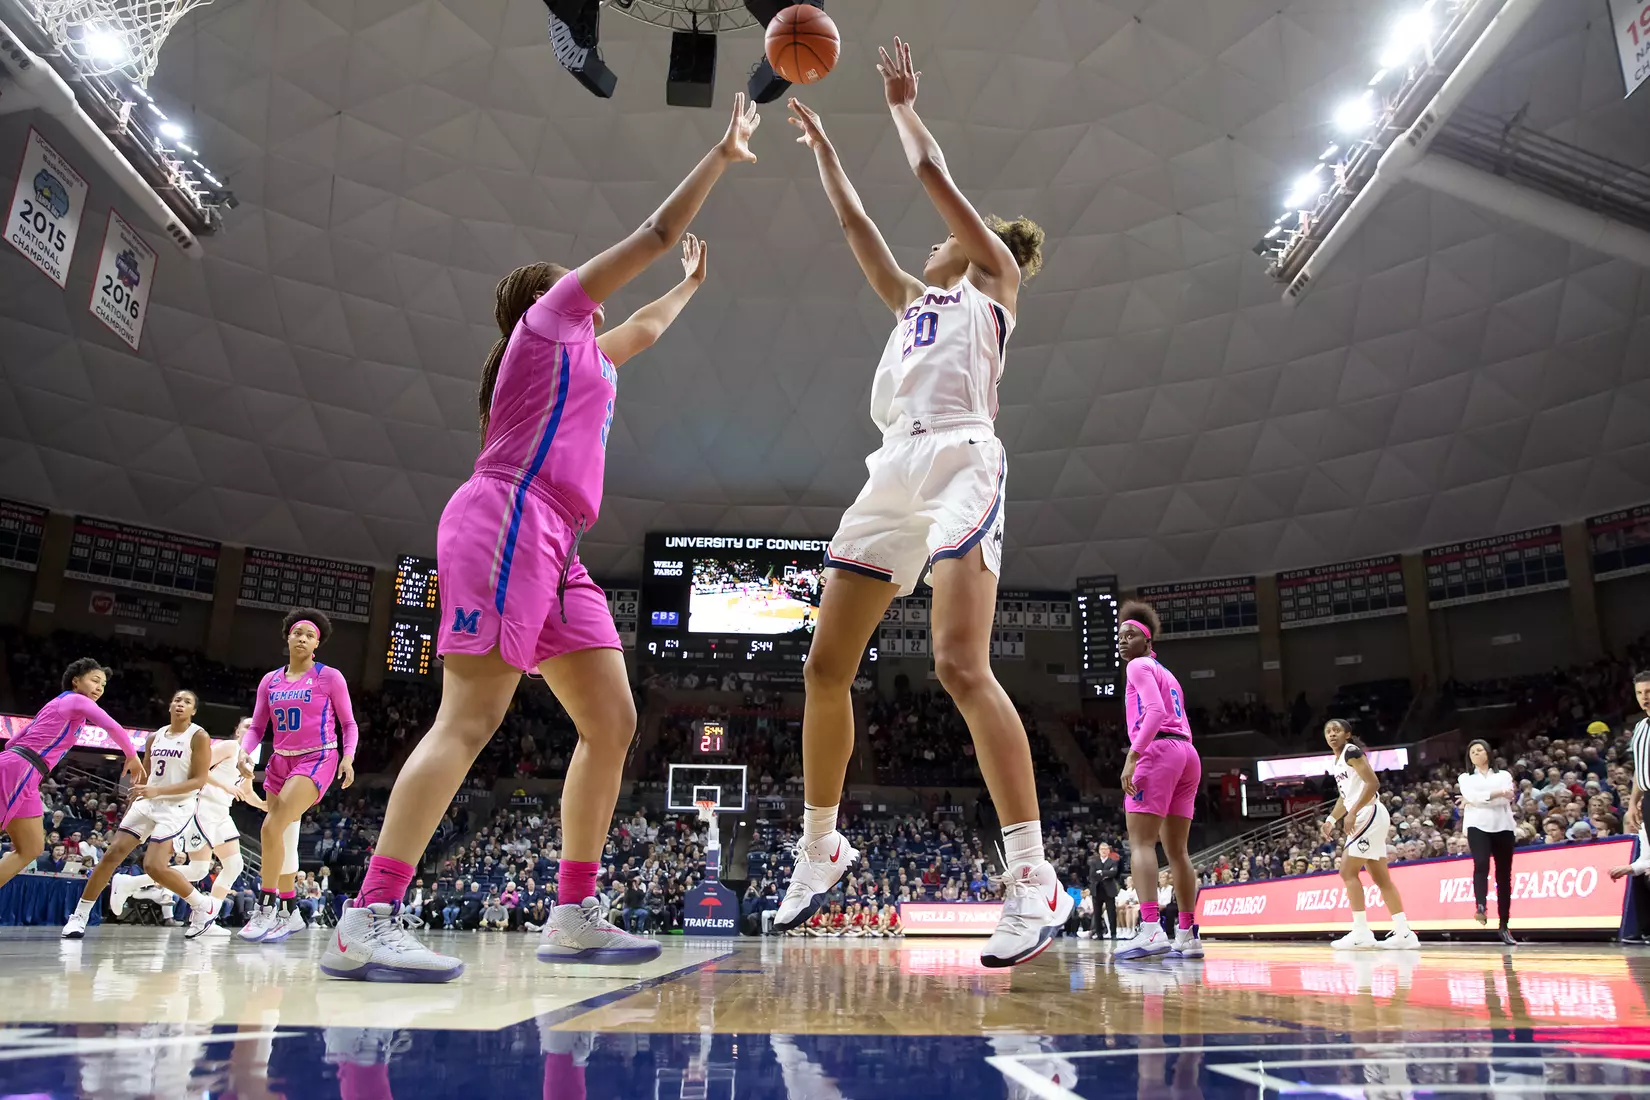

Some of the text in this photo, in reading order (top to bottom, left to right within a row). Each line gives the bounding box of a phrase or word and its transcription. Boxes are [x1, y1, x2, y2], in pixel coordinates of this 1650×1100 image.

[20, 198, 67, 252] 2015
[19, 223, 60, 256] NATIONAL
[12, 233, 61, 280] CHAMPIONS
[102, 275, 140, 319] 2016
[101, 297, 134, 331] NATIONAL
[96, 306, 134, 344] CHAMPIONS
[665, 536, 742, 553] UNIVERSITY
[746, 537, 764, 552] OF
[1430, 527, 1553, 557] NCAA CHAMPIONSHIP
[252, 549, 369, 575] NCAA CHAMPIONSHIP
[653, 560, 684, 570] WELLS
[1283, 556, 1395, 581] NCAA CHAMPIONSHIP
[653, 569, 680, 578] FARGO
[1143, 578, 1250, 595] NCAA CHAMPIONSHIP
[618, 602, 635, 614] 42
[651, 611, 677, 621] CBS
[884, 609, 900, 621] 52
[452, 607, 481, 635] M
[648, 641, 657, 656] 9
[751, 640, 774, 652] 5:44
[887, 639, 897, 652] 15
[911, 639, 922, 652] 22
[269, 689, 314, 706] MEMPHIS
[1093, 684, 1115, 696] 7:12
[1170, 688, 1183, 719] 3
[273, 707, 303, 733] 20
[704, 726, 725, 736] 5:44
[700, 736, 721, 752] 21
[151, 748, 184, 759] UCONN
[155, 759, 167, 777] 3
[522, 796, 539, 804] 114
[772, 801, 787, 811] 116
[950, 805, 964, 814] 116
[1511, 866, 1598, 900] FARGO
[1202, 895, 1267, 917] WELLS FARGO
[1296, 888, 1340, 912] WELLS
[684, 918, 735, 929] TRAVELERS
[909, 911, 956, 923] WELLS
